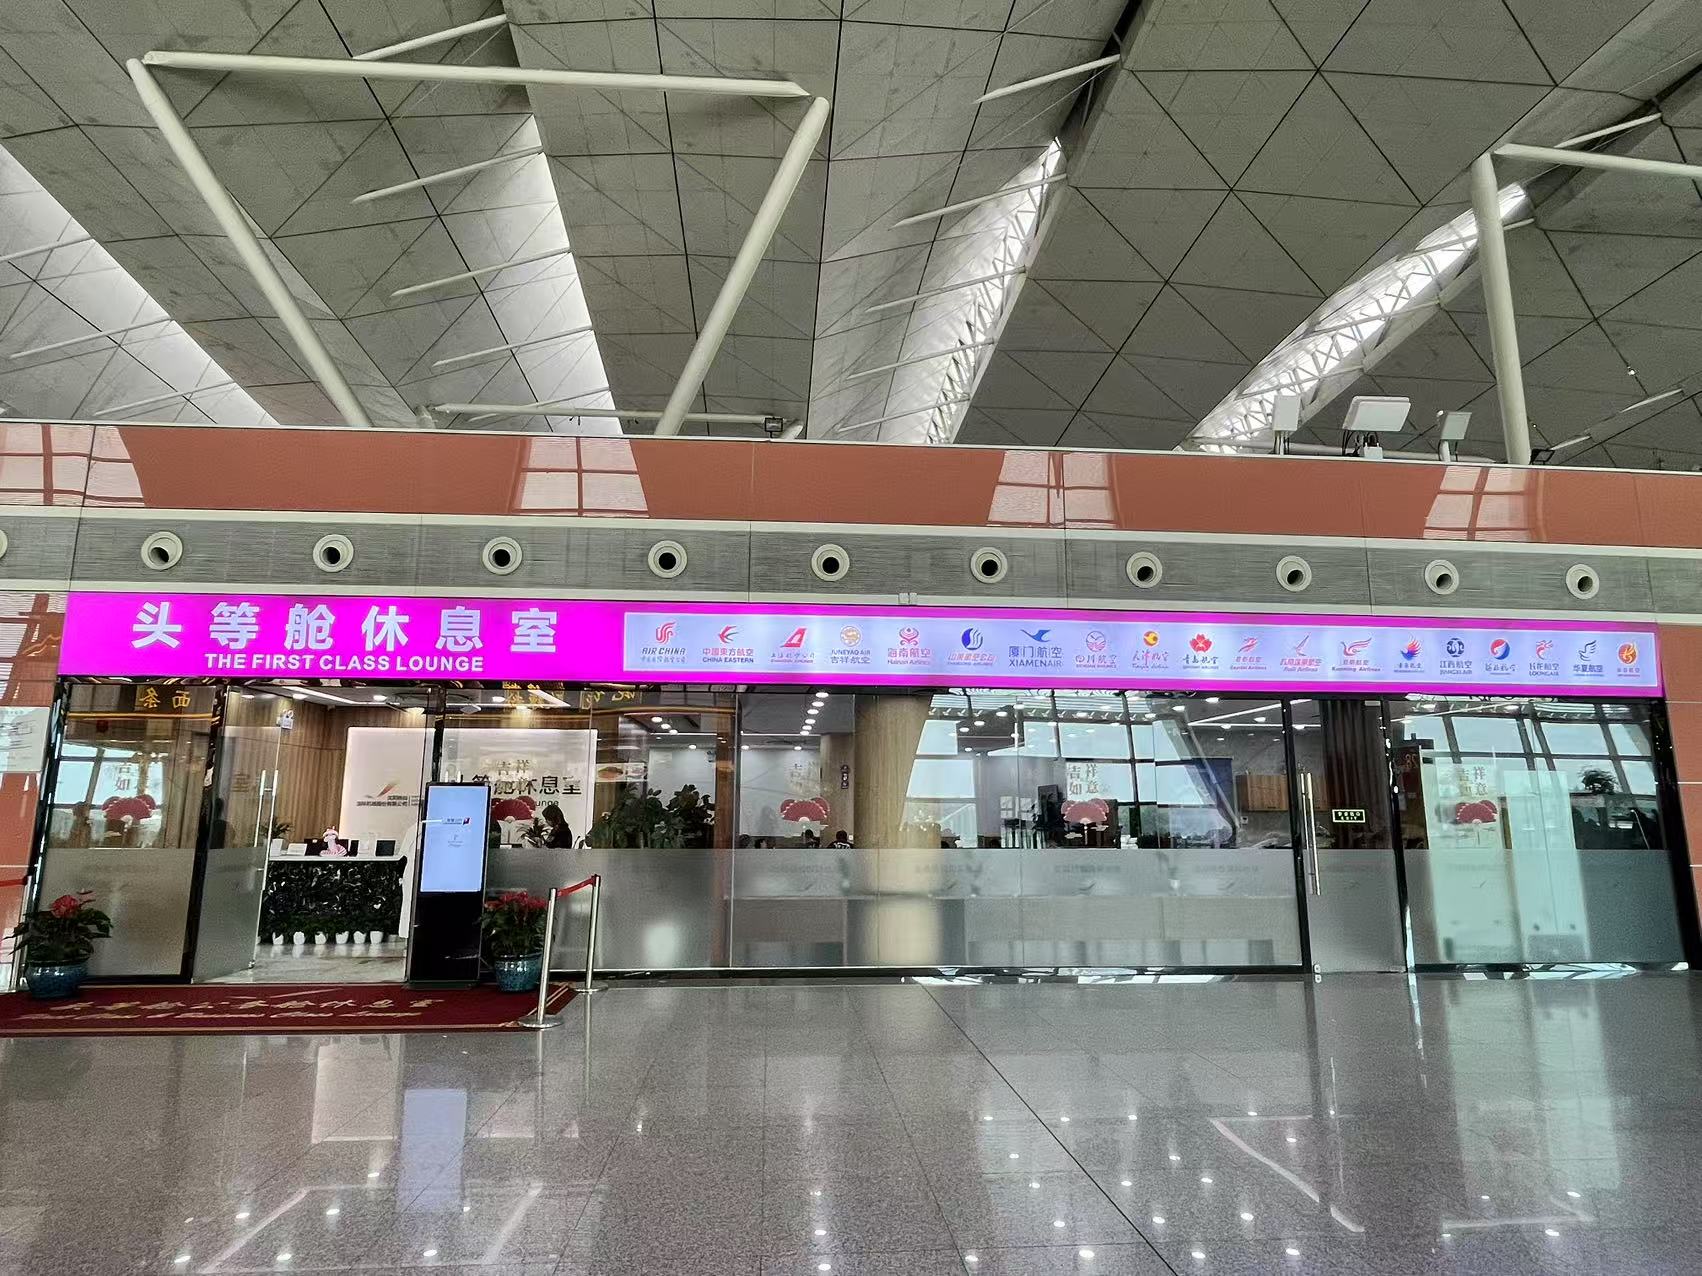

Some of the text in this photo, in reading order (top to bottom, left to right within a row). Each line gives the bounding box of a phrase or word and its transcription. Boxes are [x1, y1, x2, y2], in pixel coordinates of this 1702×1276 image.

[131, 601, 559, 653] 头等舱休息室
[642, 647, 686, 655] AIR CHINA
[887, 647, 931, 658] 海南航空
[1008, 646, 1062, 658] 厦门航空
[204, 653, 484, 673] THE FIRST CLASS LOUNGE
[1008, 659, 1062, 668] XIAMENAIR
